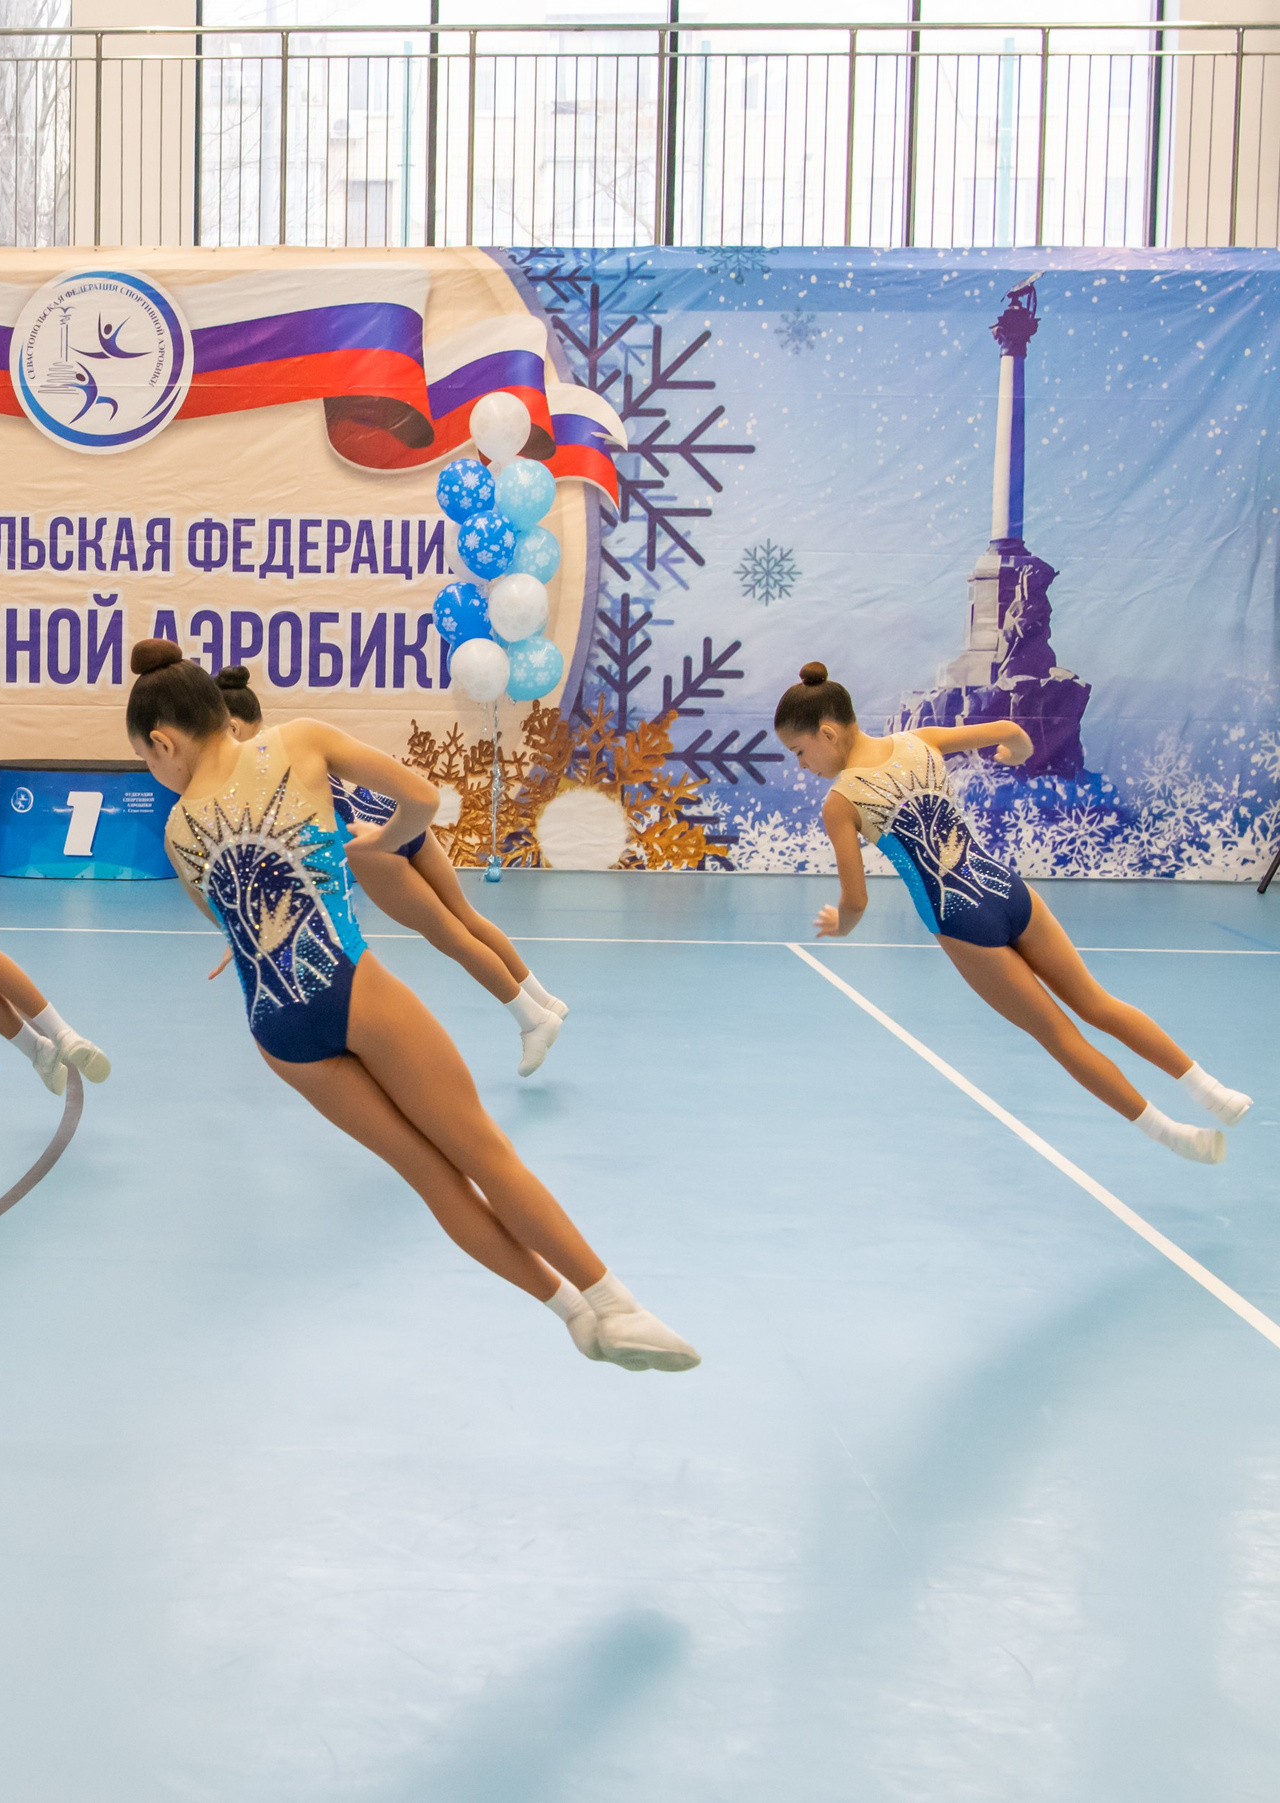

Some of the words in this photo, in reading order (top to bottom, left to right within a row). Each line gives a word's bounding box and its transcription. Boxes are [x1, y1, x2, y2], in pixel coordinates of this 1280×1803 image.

[25, 296, 65, 380] СЕВАСТОПОЛЬСКАЯ
[65, 282, 119, 298] ФЕДЕРАЦИЯ
[120, 286, 166, 337] СПОРТИВНОЙ
[186, 517, 455, 581] ФЕДЕРАЦИ
[63, 791, 104, 856] 1
